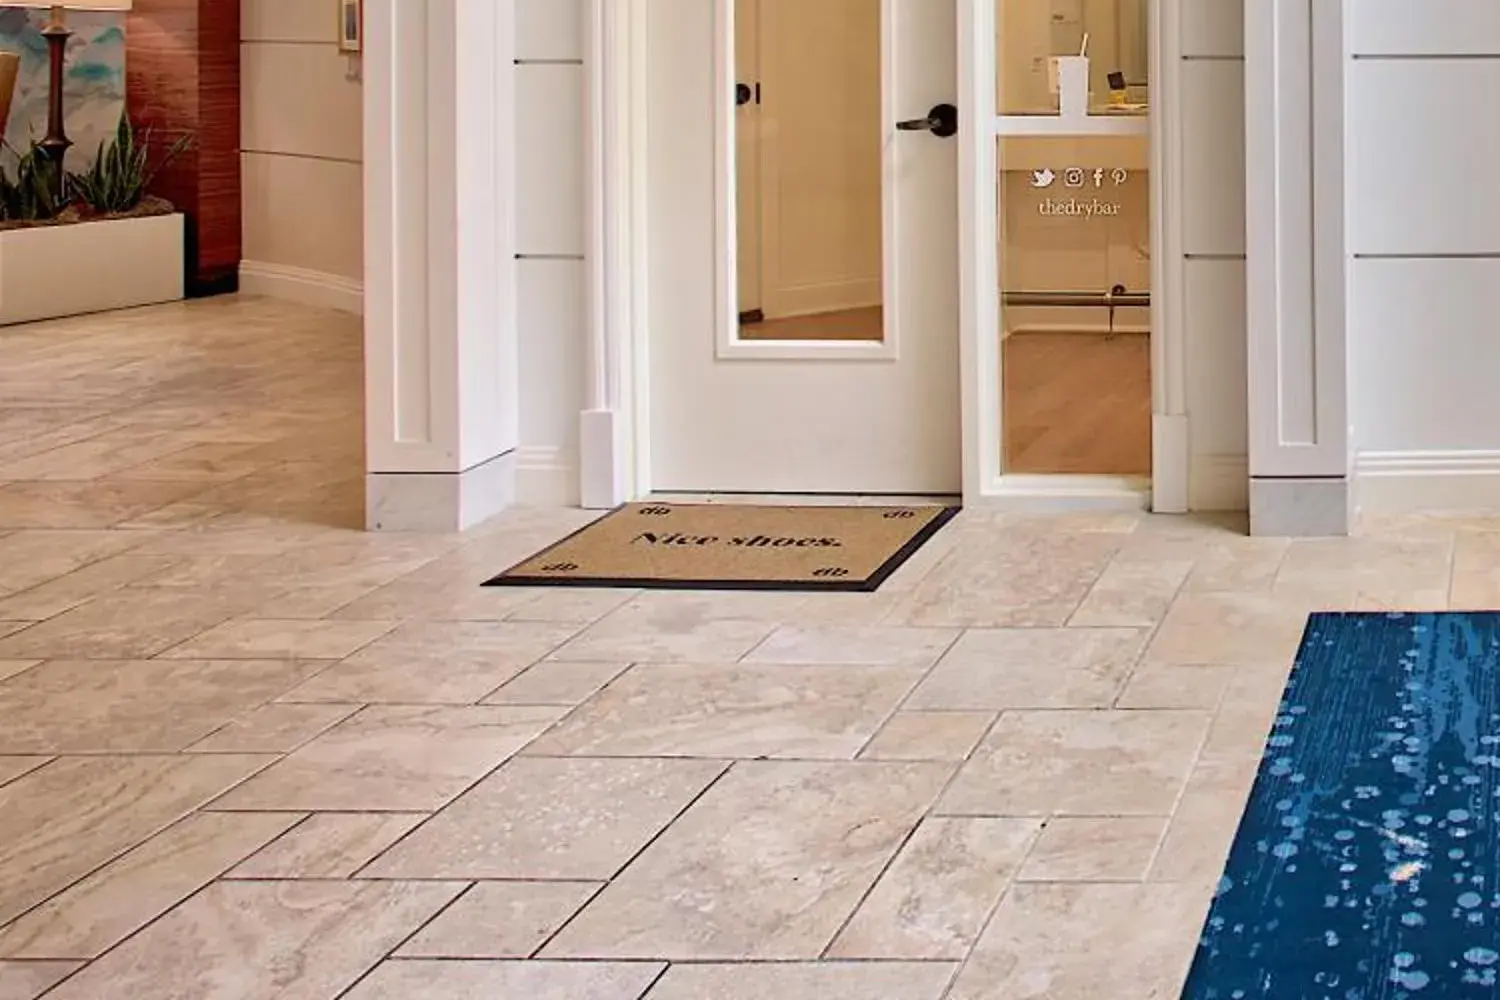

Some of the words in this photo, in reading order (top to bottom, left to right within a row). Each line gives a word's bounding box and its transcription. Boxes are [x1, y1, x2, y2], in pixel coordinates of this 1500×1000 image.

[1039, 198, 1121, 220] thedrybar
[630, 532, 719, 545] Nice
[727, 535, 842, 547] shoes.
